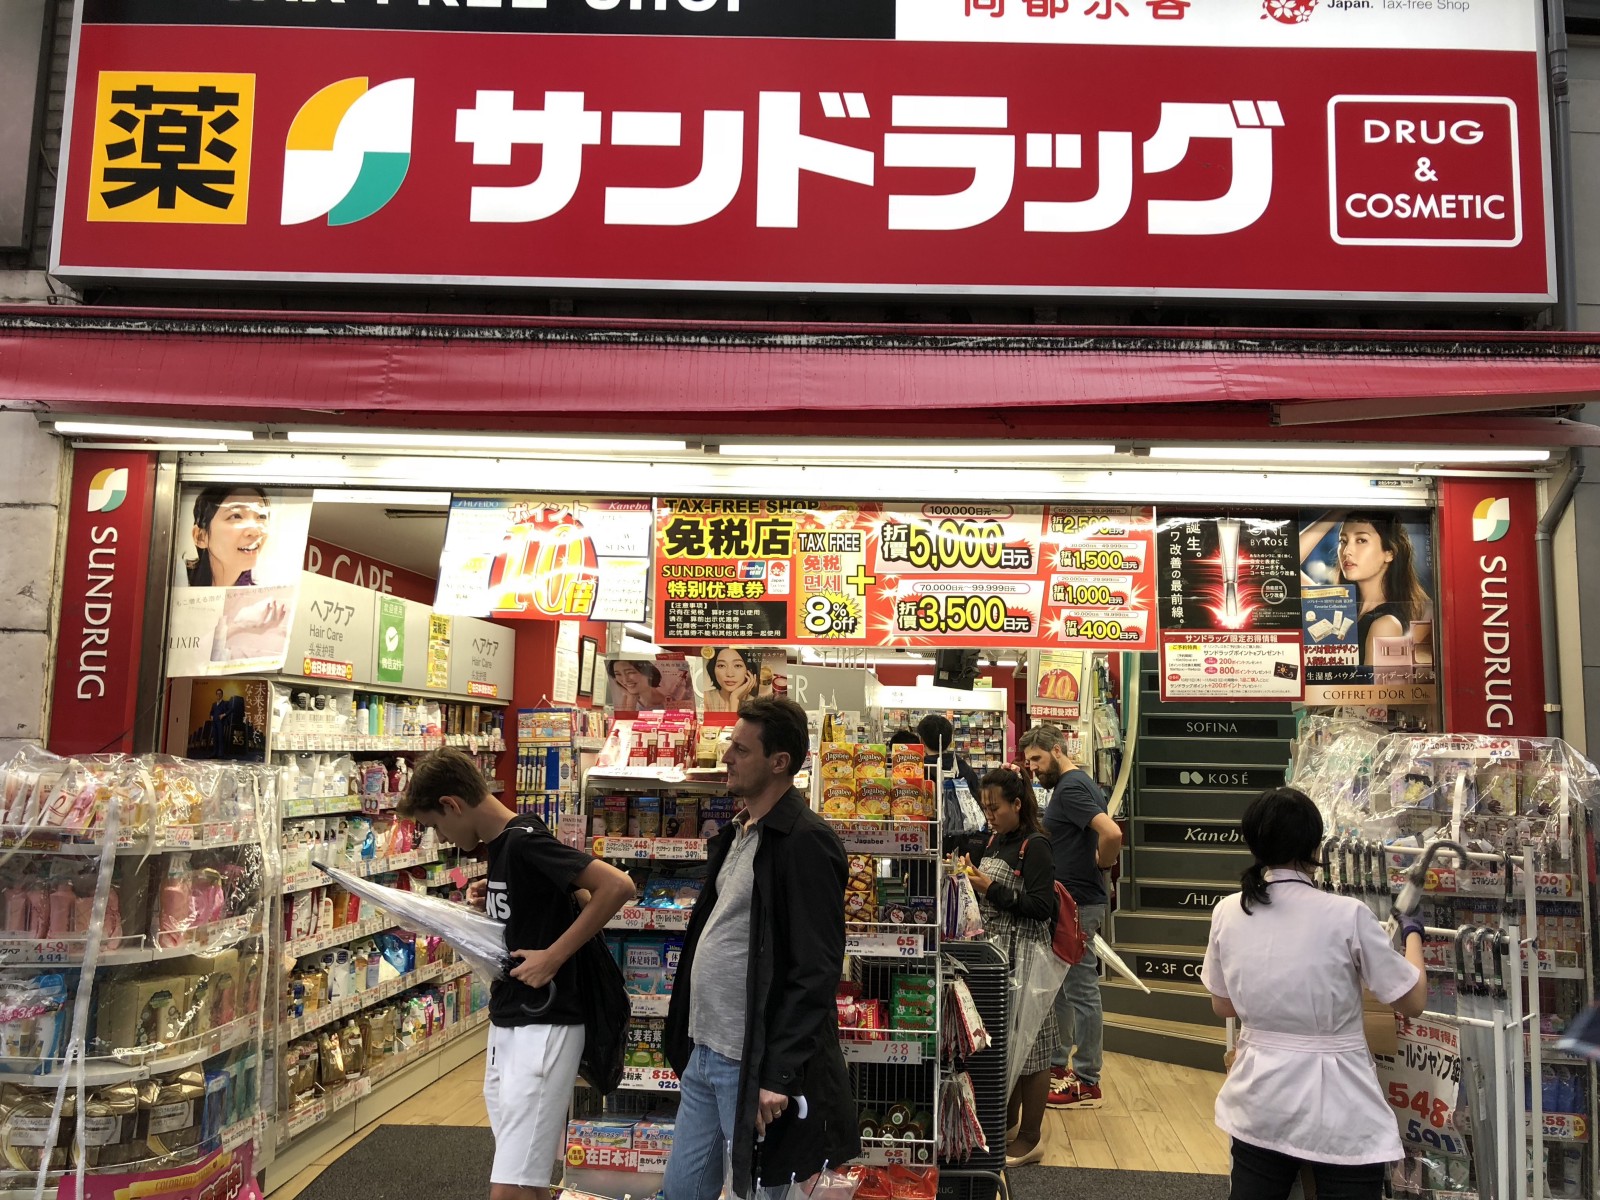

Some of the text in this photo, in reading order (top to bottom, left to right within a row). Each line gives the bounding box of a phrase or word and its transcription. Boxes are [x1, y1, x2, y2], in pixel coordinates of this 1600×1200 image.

[1363, 119, 1485, 145] DRUG
[99, 84, 240, 211] 薬
[454, 88, 1286, 236] サンドラッグ
[1413, 157, 1439, 182] &
[1344, 192, 1506, 221] COSMETIC
[507, 500, 589, 524] ポイント
[608, 502, 649, 511] Kanebo
[665, 499, 820, 514] TAX-FREE SHOP
[664, 517, 795, 558] 免税店
[798, 532, 861, 553] TAX FREE
[1185, 521, 1202, 558] 誕生。
[1250, 537, 1289, 547] BY KOSÉ
[803, 554, 842, 572] 免税
[662, 565, 736, 578] SUNDRUG
[666, 580, 766, 599] 特别优惠券
[803, 574, 842, 593] 면세
[76, 526, 119, 700] SUNDRUG
[310, 599, 356, 627] ヘアケア
[832, 616, 856, 632] off
[309, 623, 344, 643] Hair Care
[1185, 634, 1278, 643] サンドラッグ限定お得情報
[472, 637, 499, 657] ヘアケア
[1479, 555, 1515, 729] SUNDRUG
[1322, 690, 1374, 700] COFFRET
[1378, 688, 1406, 699] D'OR
[1186, 721, 1238, 733] SOFINA
[1208, 771, 1249, 785] KOSÉ
[854, 837, 884, 845] Jagabee
[894, 832, 919, 843] 148
[633, 840, 649, 850] 448
[684, 840, 699, 850] 368
[900, 843, 920, 853] 159
[634, 850, 648, 858] 483
[684, 850, 698, 858] 397
[1437, 872, 1457, 889] 在
[485, 891, 512, 920] NS
[34, 941, 67, 954] 458
[896, 935, 915, 947] 65
[37, 953, 65, 963] 494
[899, 947, 915, 956] 70
[629, 955, 659, 966] 休足時間
[867, 1003, 876, 1030] Rumm
[883, 1043, 909, 1055] 138
[886, 1055, 908, 1063] 149
[652, 1070, 678, 1080] 858
[657, 1081, 679, 1089] 926
[1387, 1081, 1450, 1129] 548
[1405, 1118, 1457, 1153] 591
[585, 1149, 639, 1168] 在日本很
[884, 1149, 904, 1157] 68
[888, 1157, 904, 1165] 73
